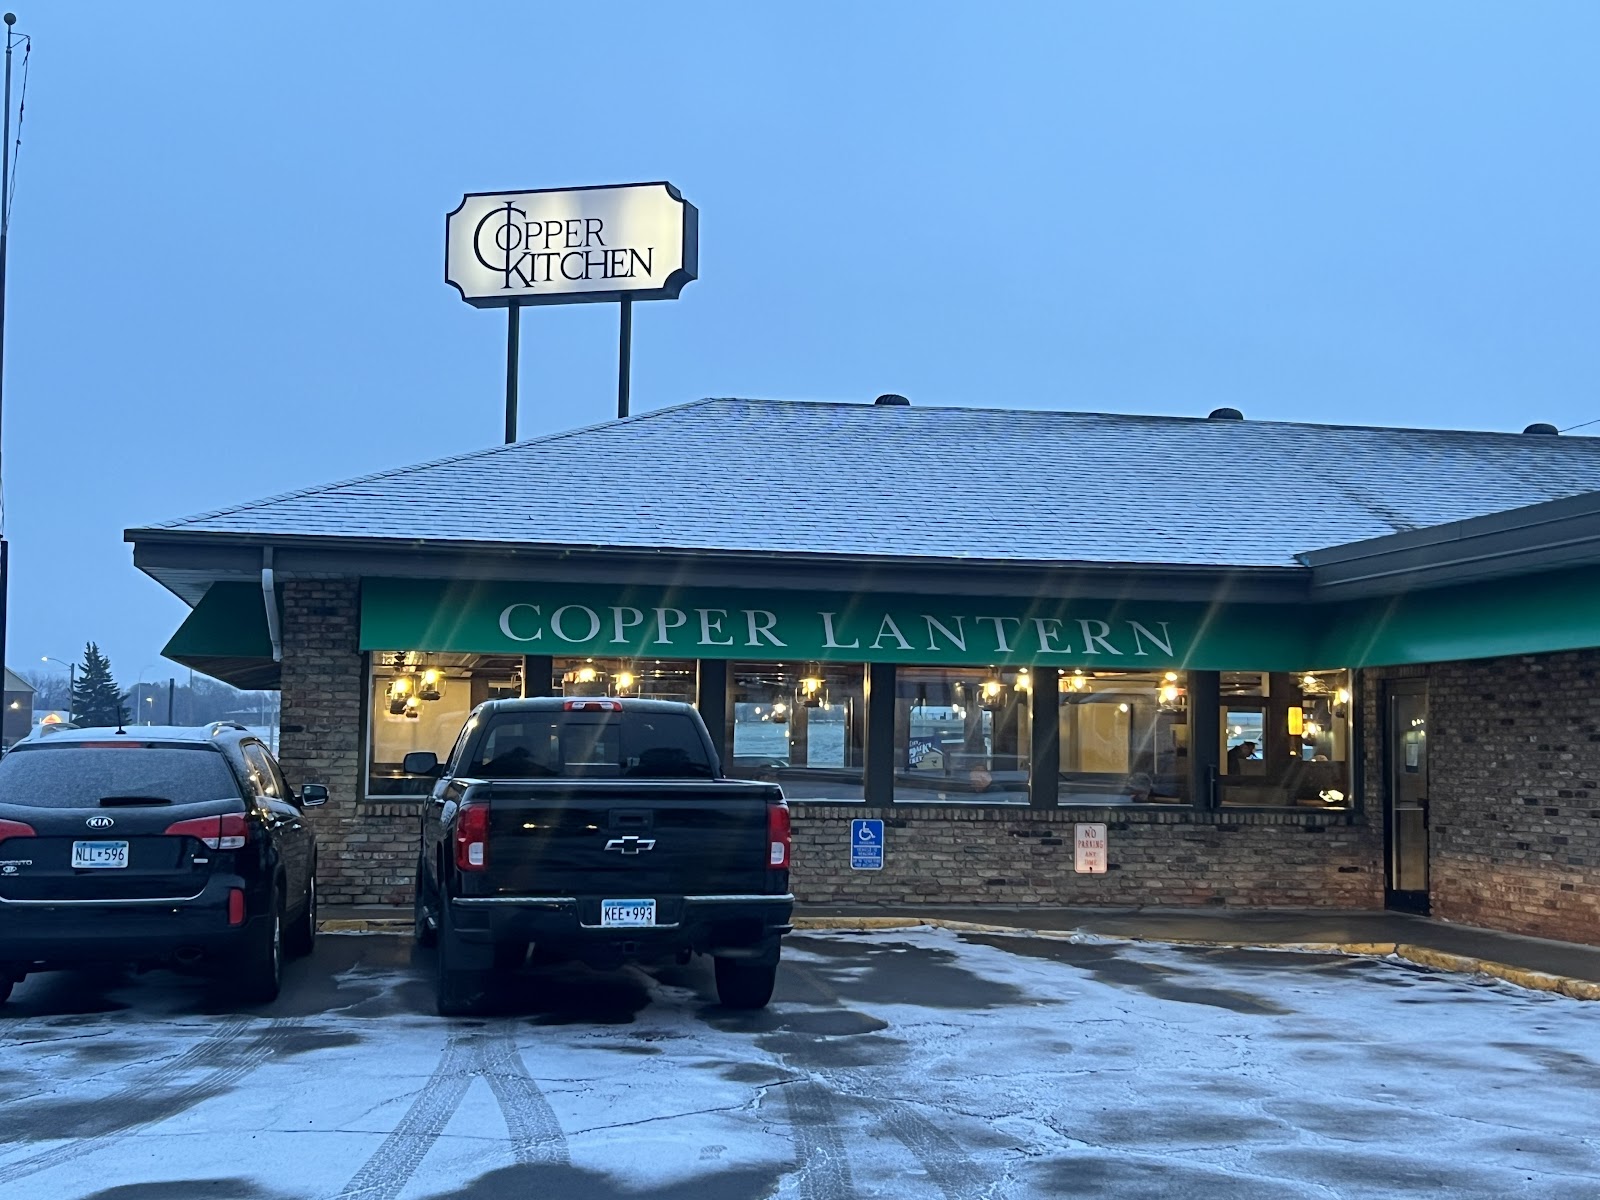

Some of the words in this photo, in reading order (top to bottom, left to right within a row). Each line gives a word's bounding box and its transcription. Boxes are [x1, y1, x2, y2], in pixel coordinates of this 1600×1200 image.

[473, 201, 607, 272] COPPER
[500, 246, 654, 290] KITCHEN
[499, 603, 788, 648] COPPER
[816, 611, 1177, 657] LANTERN
[90, 818, 109, 827] KIA
[1084, 828, 1097, 839] NO
[1077, 839, 1104, 849] PARKING
[75, 847, 96, 862] NLL
[104, 847, 125, 861] 596
[1085, 850, 1097, 858] ANY
[604, 906, 625, 921] KEE
[632, 906, 653, 921] 993
